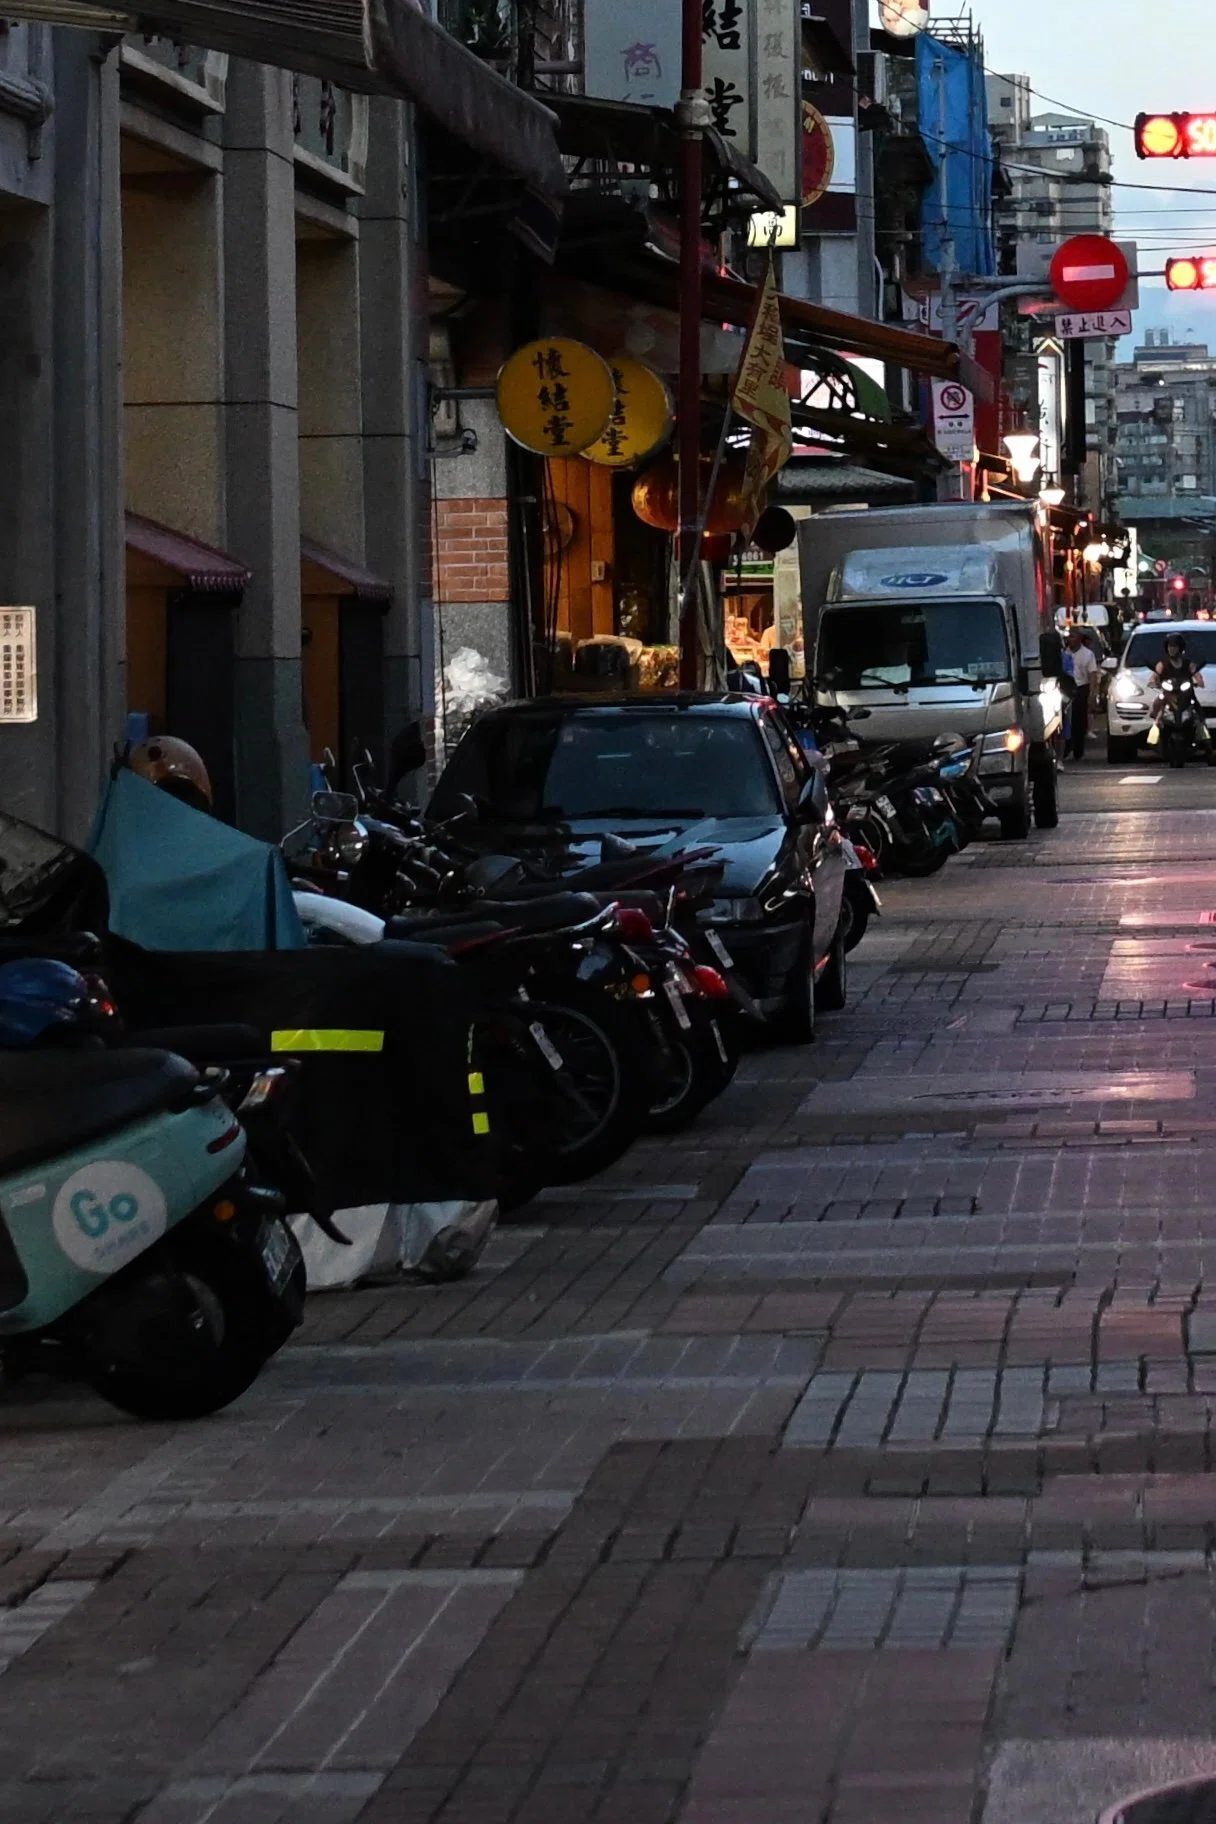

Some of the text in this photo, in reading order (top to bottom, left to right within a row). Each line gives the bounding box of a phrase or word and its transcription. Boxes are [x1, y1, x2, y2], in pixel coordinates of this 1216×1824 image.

[1061, 315, 1127, 335] 禁止進入
[532, 347, 575, 447] 懷結堂
[71, 1191, 138, 1237] Go
